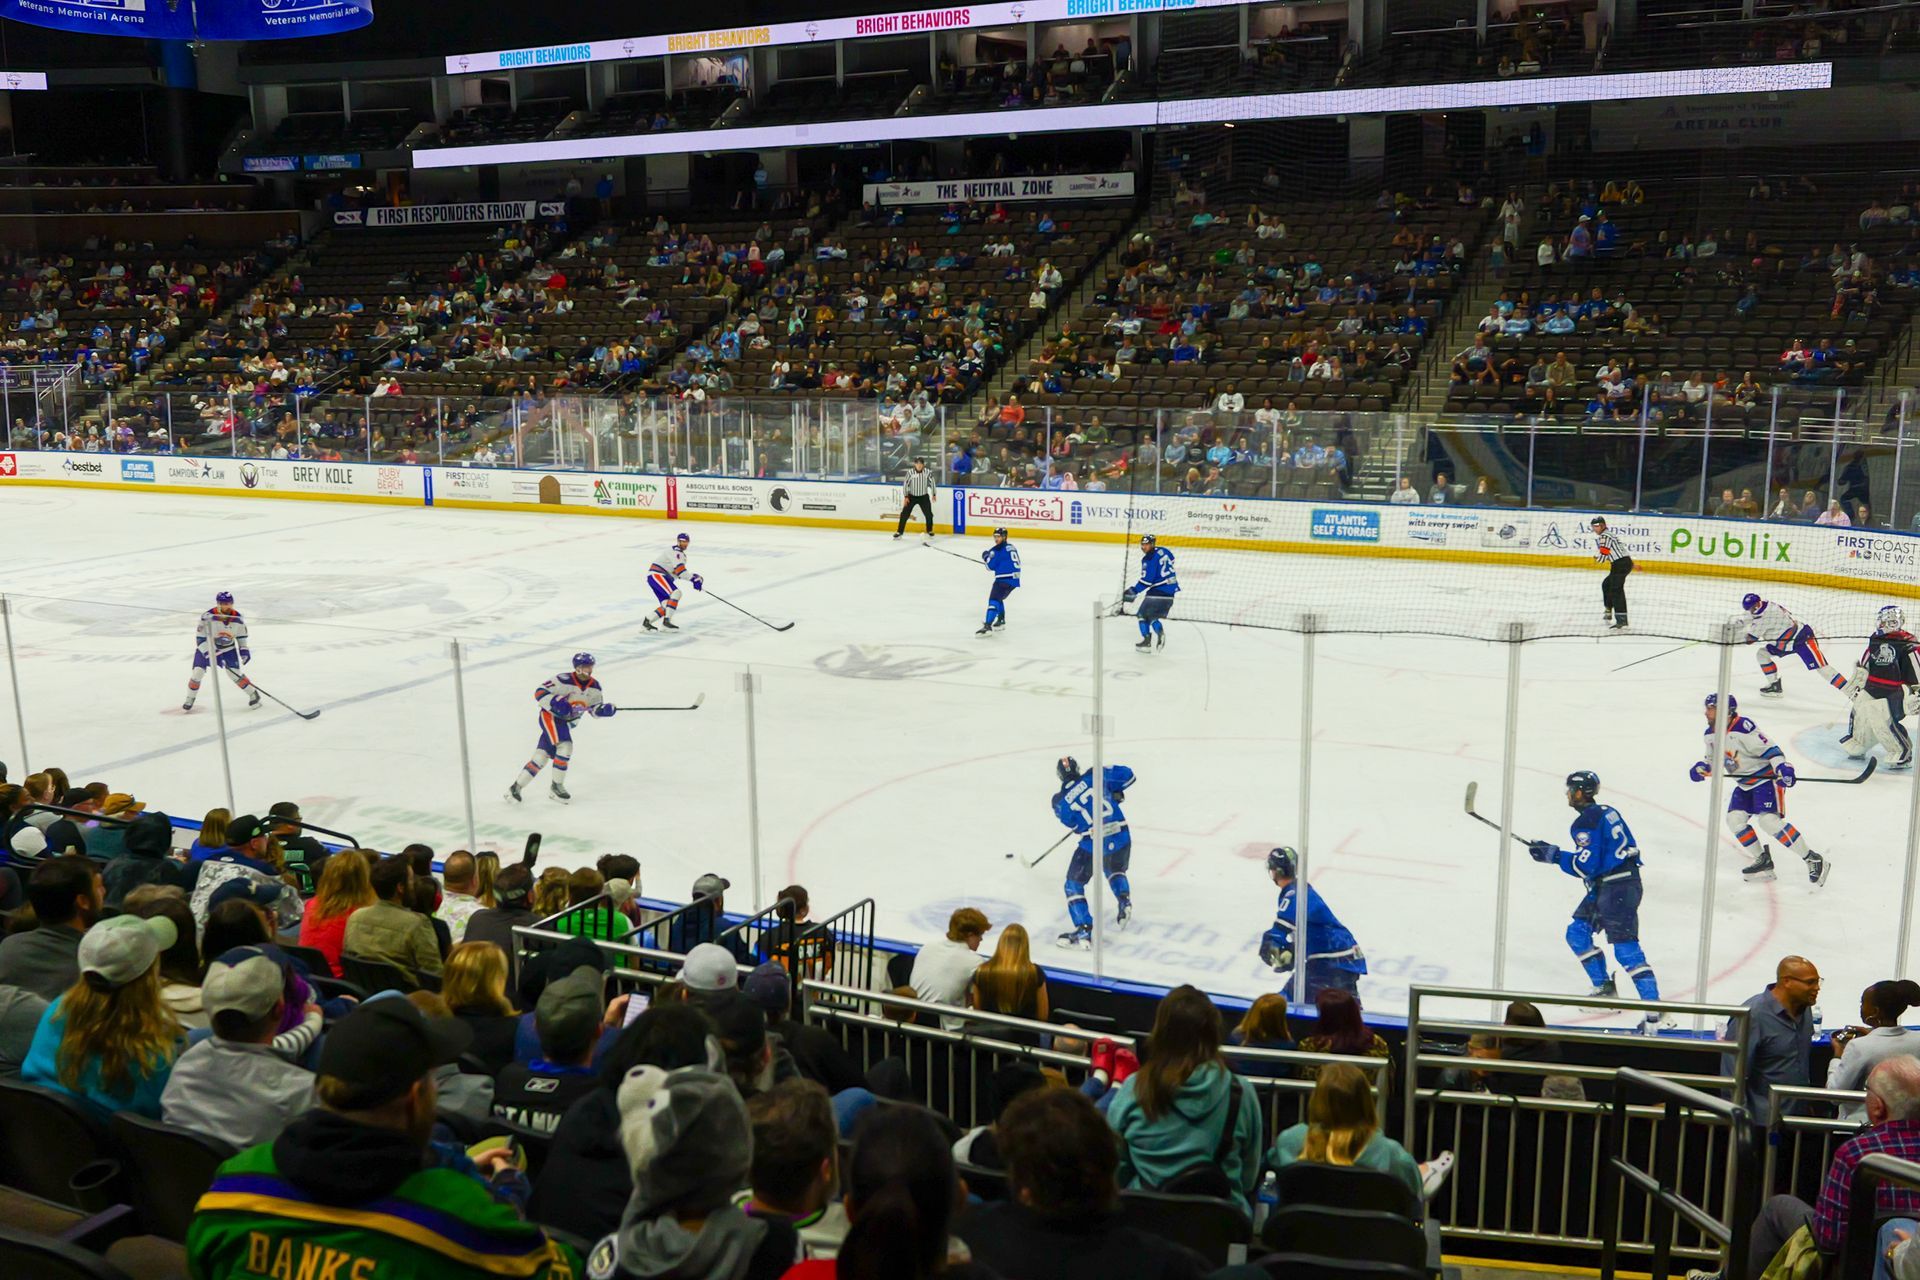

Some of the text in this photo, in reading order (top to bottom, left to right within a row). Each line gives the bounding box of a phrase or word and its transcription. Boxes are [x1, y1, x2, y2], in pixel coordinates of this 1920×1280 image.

[19, 0, 144, 24] Veterans Memorial Arena
[1068, 0, 1114, 15] BRIGHT
[265, 6, 360, 25] Veterans Memorial Arena
[856, 9, 970, 34] BRIGHT BEHAVIORS
[668, 27, 770, 51] BRIGHT BEHAVIORS
[499, 44, 591, 67] BRIGHT BEHAVIORS
[936, 180, 1053, 199] THE NEUTRAL ZONE
[377, 202, 527, 224] FIRST RESPONDERS FRIDAY
[539, 202, 565, 216] CSX
[334, 211, 362, 224] CSX
[72, 461, 103, 473] bestbet
[169, 468, 225, 480] CAMPIONE LAW
[261, 466, 279, 477] True
[293, 466, 353, 484] GREY KOLE
[377, 479, 404, 490] BEACH
[466, 480, 489, 488] NEWS
[608, 480, 657, 493] campers
[617, 493, 654, 507] inn RV
[984, 496, 1046, 507] DARLEY'S
[980, 505, 1051, 518] PLUMBING
[1086, 506, 1167, 521] WEST SHORE
[1187, 511, 1213, 521] Boring
[1215, 513, 1232, 521] gets
[1250, 515, 1272, 523] here.
[1324, 514, 1367, 526] ATLANTIC
[1408, 519, 1479, 530] with every swipe!
[1313, 525, 1378, 537] SELF STORAGE
[1574, 522, 1650, 536] Asnsion
[1573, 538, 1591, 550] St.
[1670, 528, 1791, 563] Publix
[1837, 535, 1919, 554] FIRSTCOAST
[1873, 552, 1915, 566] NEWS
[246, 1231, 376, 1280] BANKS
